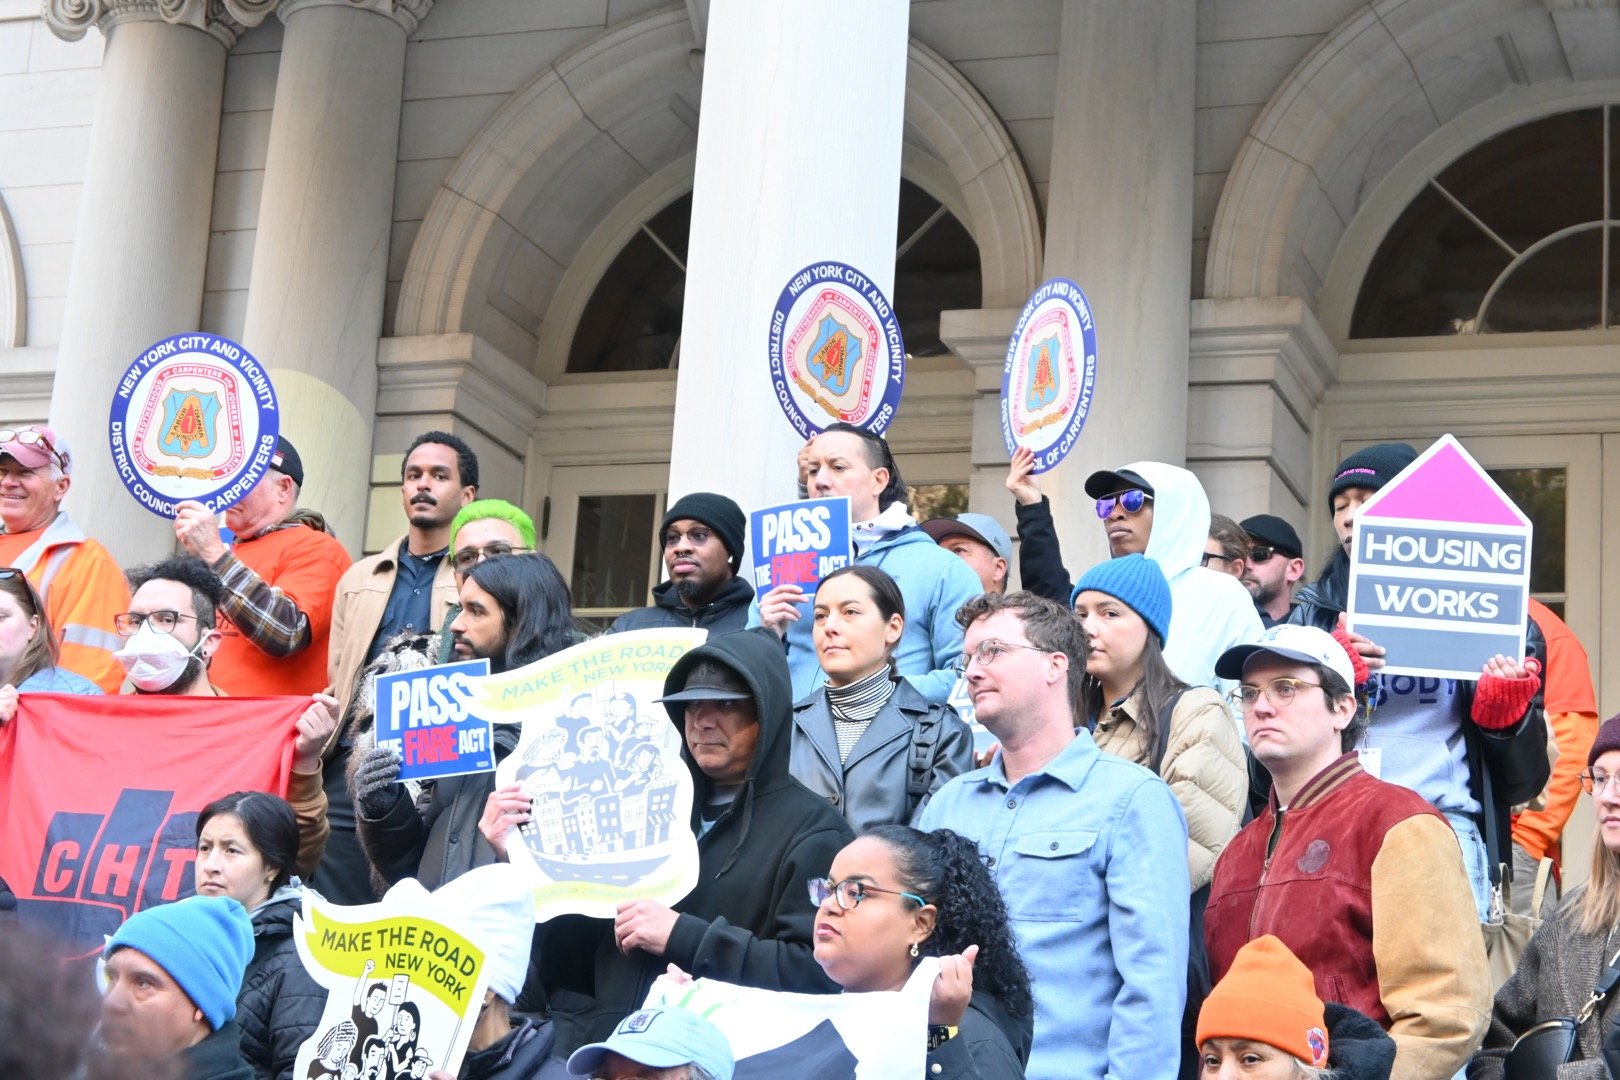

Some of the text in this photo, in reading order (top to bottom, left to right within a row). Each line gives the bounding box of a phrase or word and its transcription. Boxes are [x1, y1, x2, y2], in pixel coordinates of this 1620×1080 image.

[789, 265, 901, 384] NEW YORK CITY AND VICINITY
[818, 338, 837, 359] LABOR
[1005, 281, 1092, 373] NEW YORK CITY AND VICINITY
[119, 336, 275, 410] NEW YORK CITY AND VICINITY
[172, 366, 223, 379] CARPENTERS
[228, 391, 239, 426] JOINERS
[771, 310, 808, 436] DISTRICT COUNCIL
[170, 408, 188, 435] LABOR
[194, 409, 204, 439] OMNIA
[1001, 398, 1015, 455] DISTRICT
[1047, 448, 1061, 466] OF
[1060, 354, 1095, 454] CARPENTERS
[112, 422, 136, 484] DISTRICT
[205, 435, 274, 513] CARPENTERS
[762, 506, 831, 558] PASS
[1365, 533, 1522, 570] HOUSING
[755, 563, 772, 588] THE
[1374, 584, 1499, 619] WORKS
[502, 644, 685, 700] MAKE THE ROAD
[583, 663, 627, 684] NEW
[390, 672, 471, 731] PASS
[404, 725, 459, 766] FARE
[459, 727, 486, 755] ACT
[321, 926, 476, 977] MAKE THE ROAD
[385, 953, 467, 1001] NEW YORK
